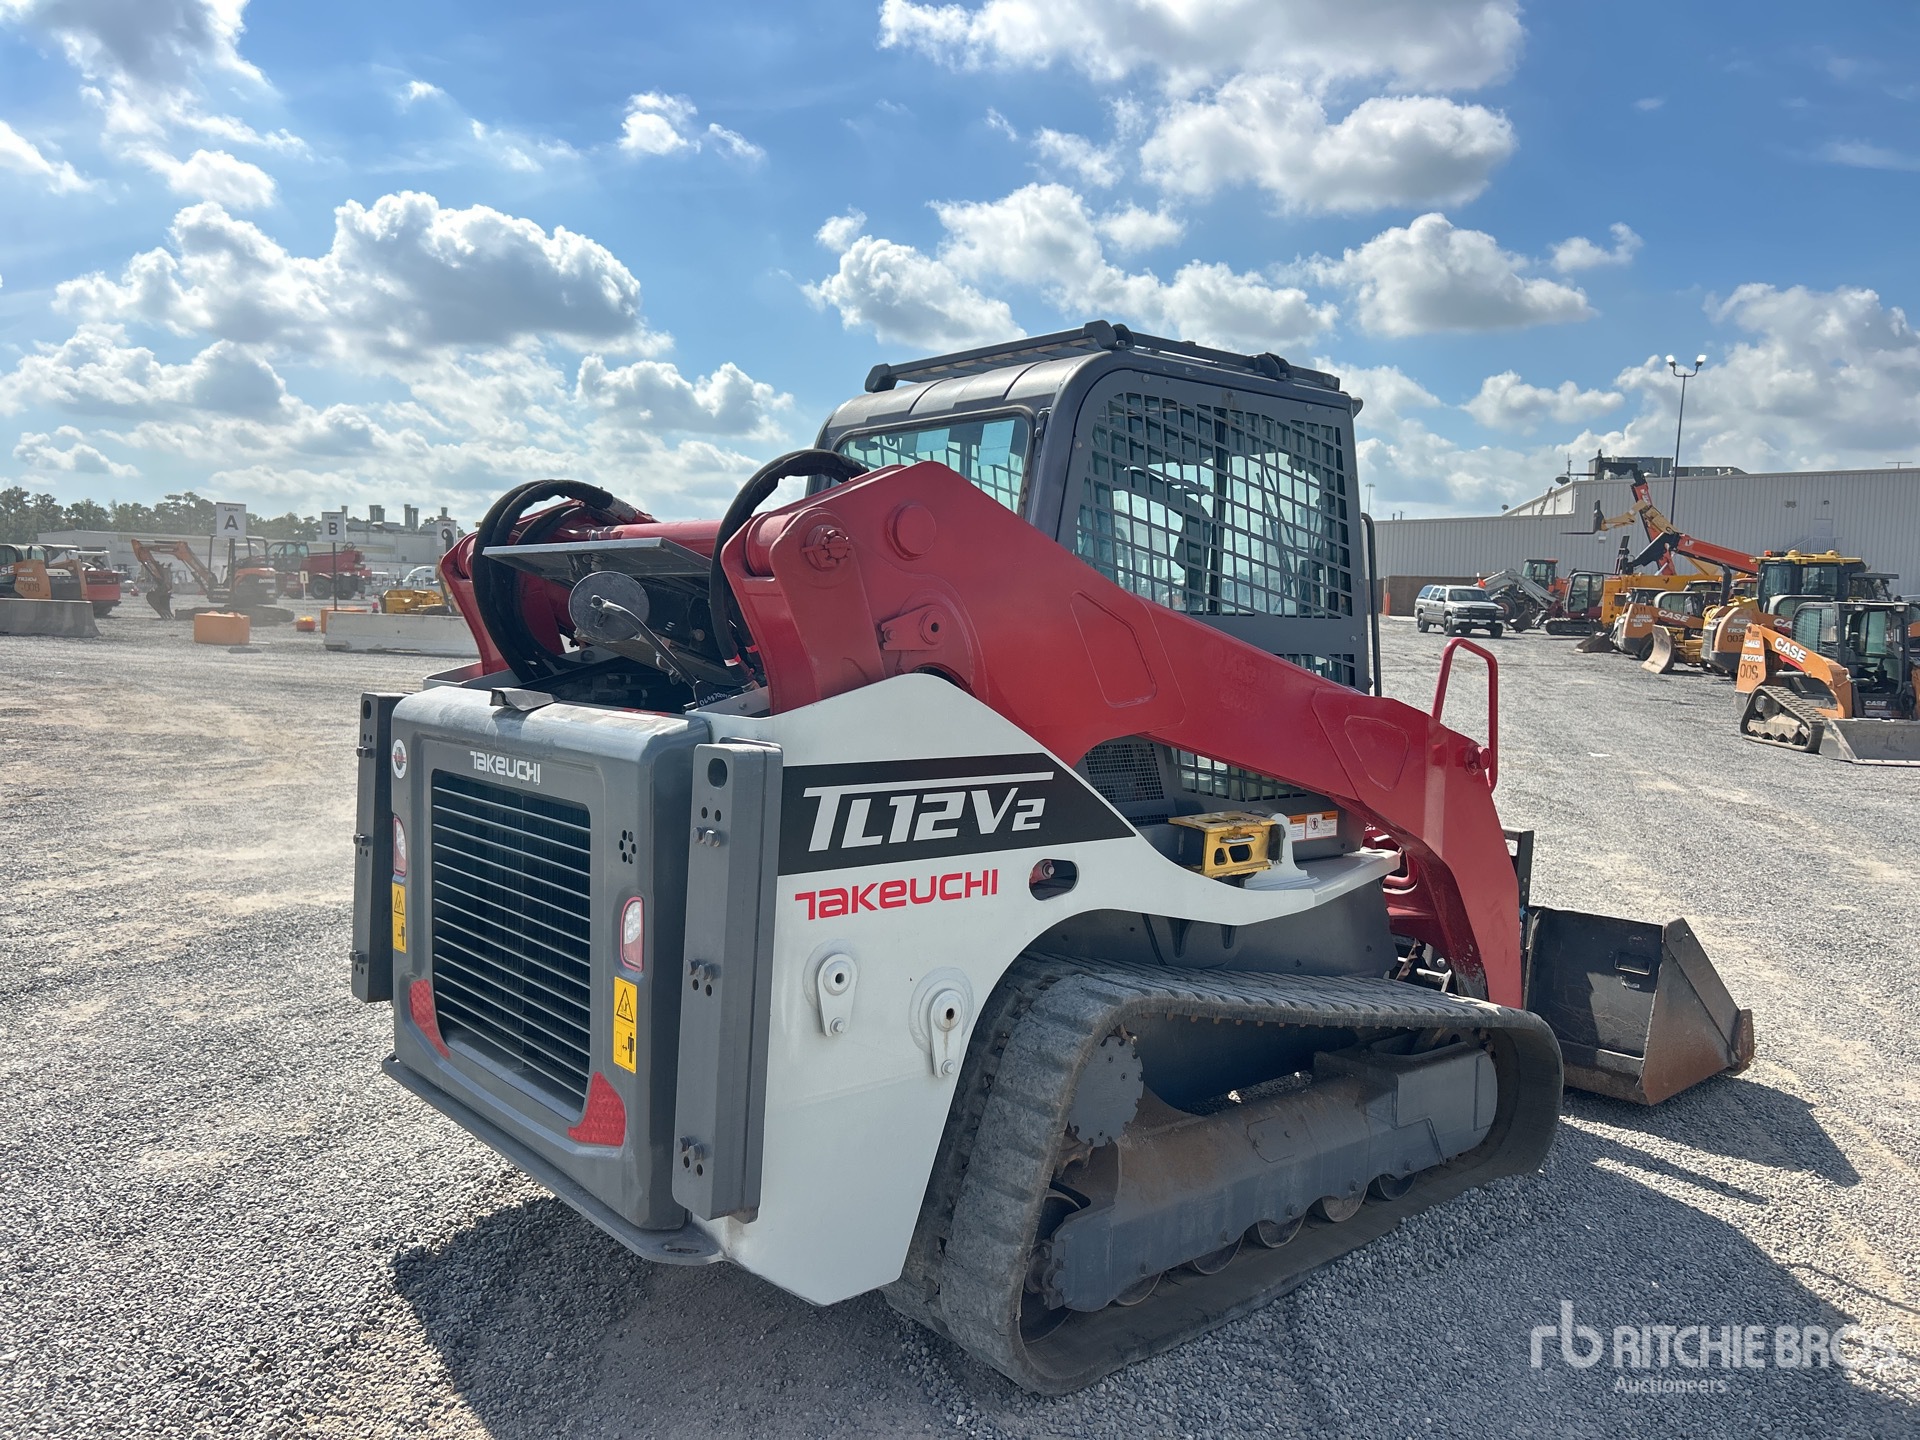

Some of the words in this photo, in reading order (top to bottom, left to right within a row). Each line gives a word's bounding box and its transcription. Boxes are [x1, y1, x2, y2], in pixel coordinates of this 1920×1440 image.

[223, 514, 239, 531] A
[328, 522, 338, 536] B
[302, 573, 307, 582] 1
[1658, 609, 1690, 623] CASE
[1774, 637, 1807, 663] CASE
[469, 749, 542, 785] TAKEUCHI
[795, 868, 999, 921] TAKEUCHI
